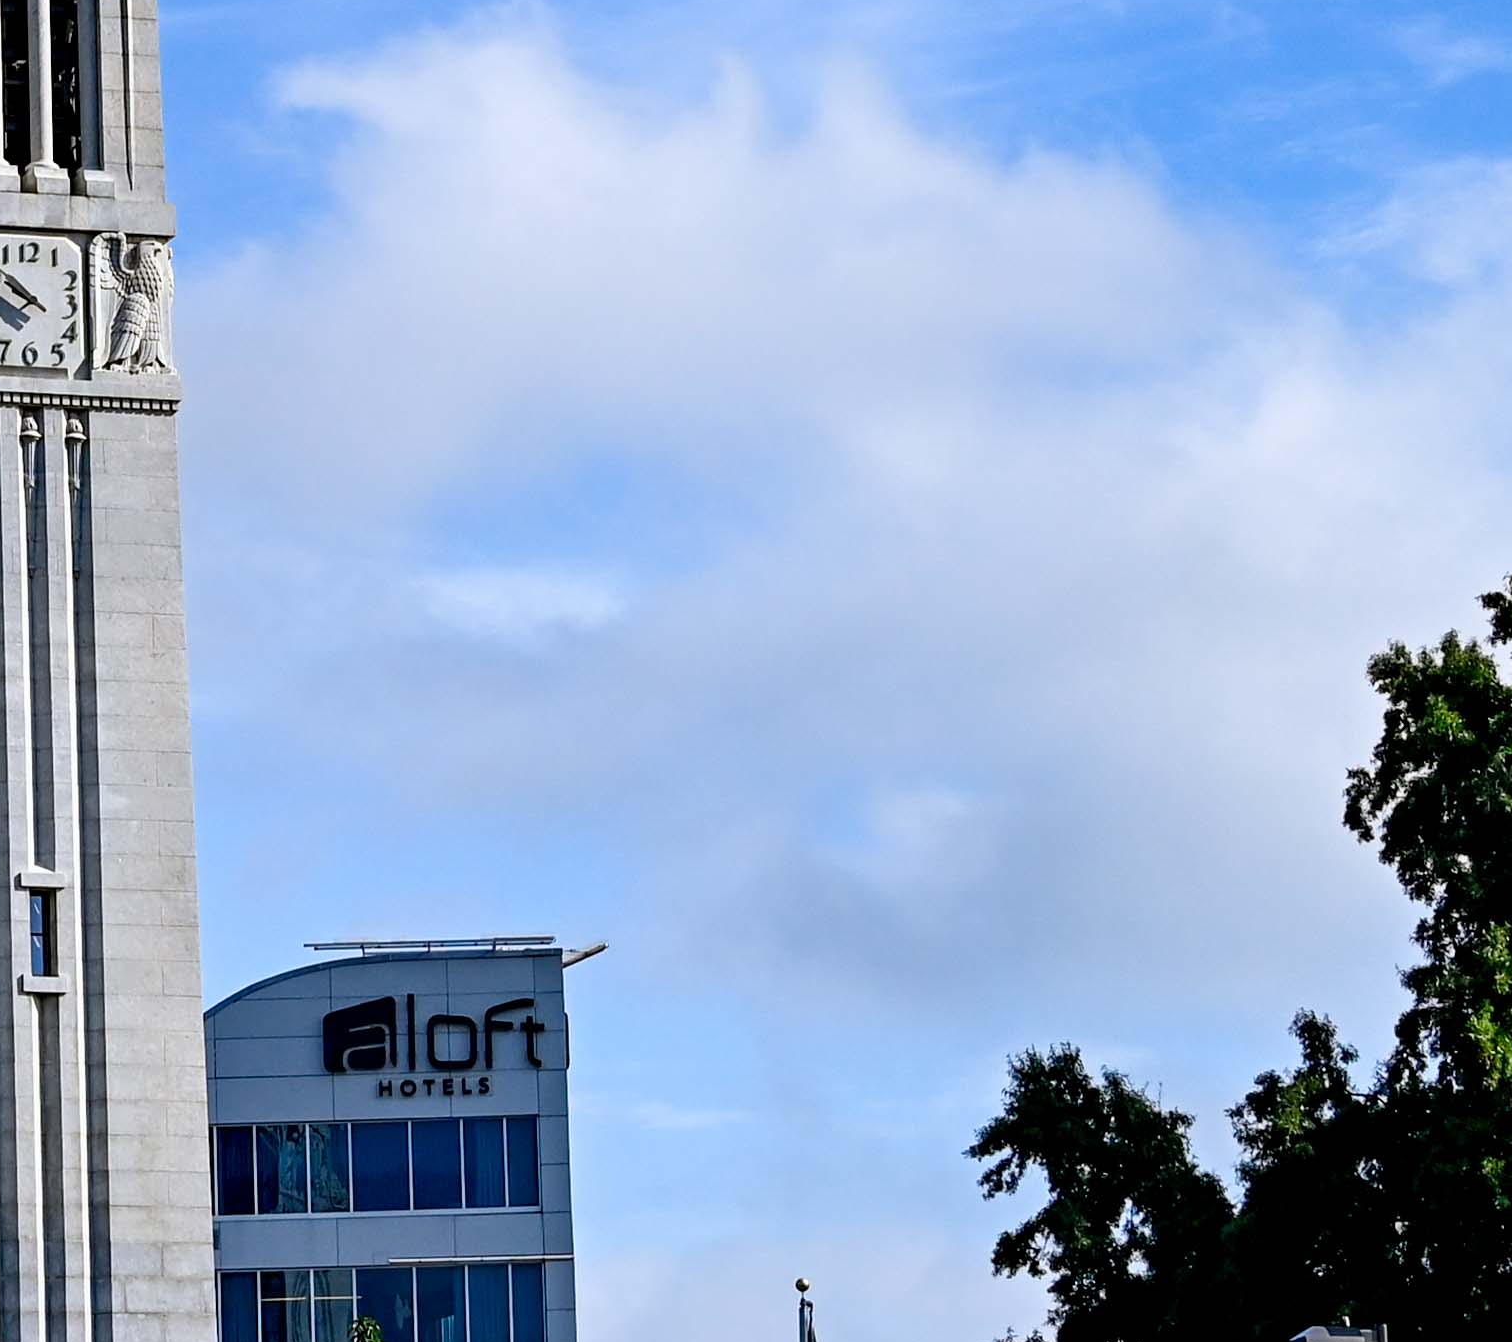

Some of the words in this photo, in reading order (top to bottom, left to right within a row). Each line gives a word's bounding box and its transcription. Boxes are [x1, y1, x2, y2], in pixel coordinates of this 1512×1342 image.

[18, 242, 40, 263] 12
[51, 246, 58, 268] 1
[63, 270, 78, 291] 2
[61, 294, 78, 320] 3
[61, 320, 78, 344] 4
[21, 341, 39, 366] 6
[50, 343, 66, 367] 5
[323, 993, 544, 1072] aloft
[378, 1076, 491, 1097] HOTELS
